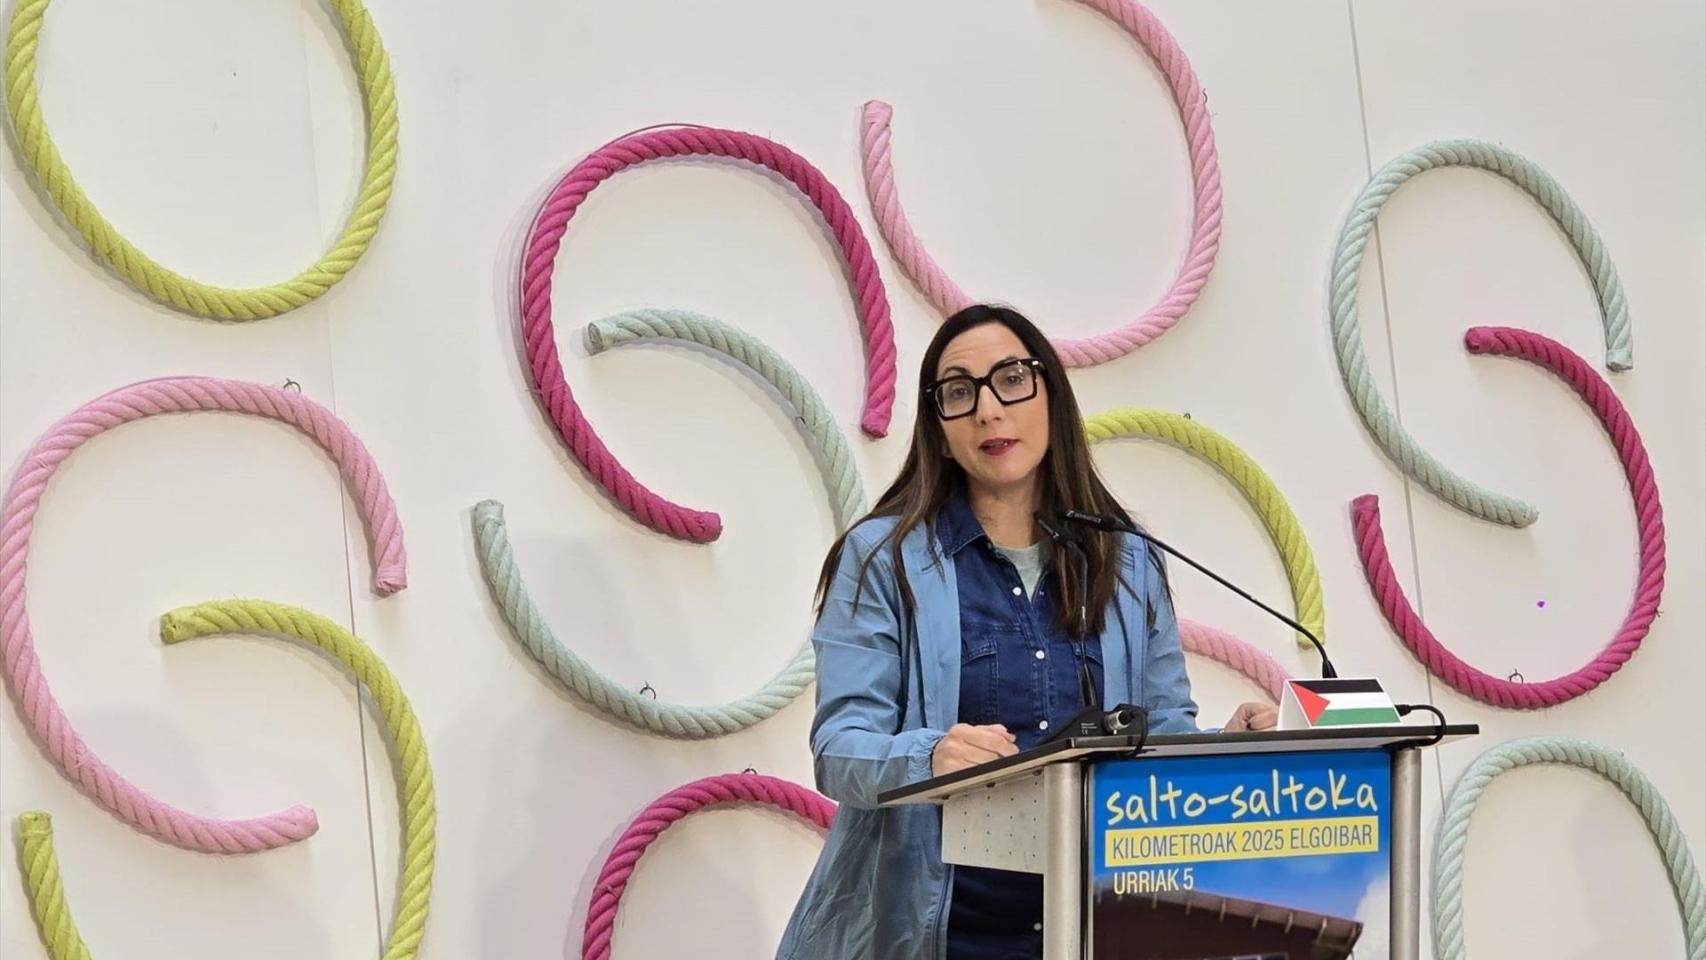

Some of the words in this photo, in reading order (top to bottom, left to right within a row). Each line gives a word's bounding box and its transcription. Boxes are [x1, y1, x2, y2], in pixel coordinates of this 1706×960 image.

[1112, 831, 1237, 859] KILOMETROAK
[1242, 828, 1284, 851] 2025
[1290, 824, 1373, 849] ELGOIBAR
[1113, 869, 1179, 895] URRIAK
[1183, 868, 1194, 890] 5
